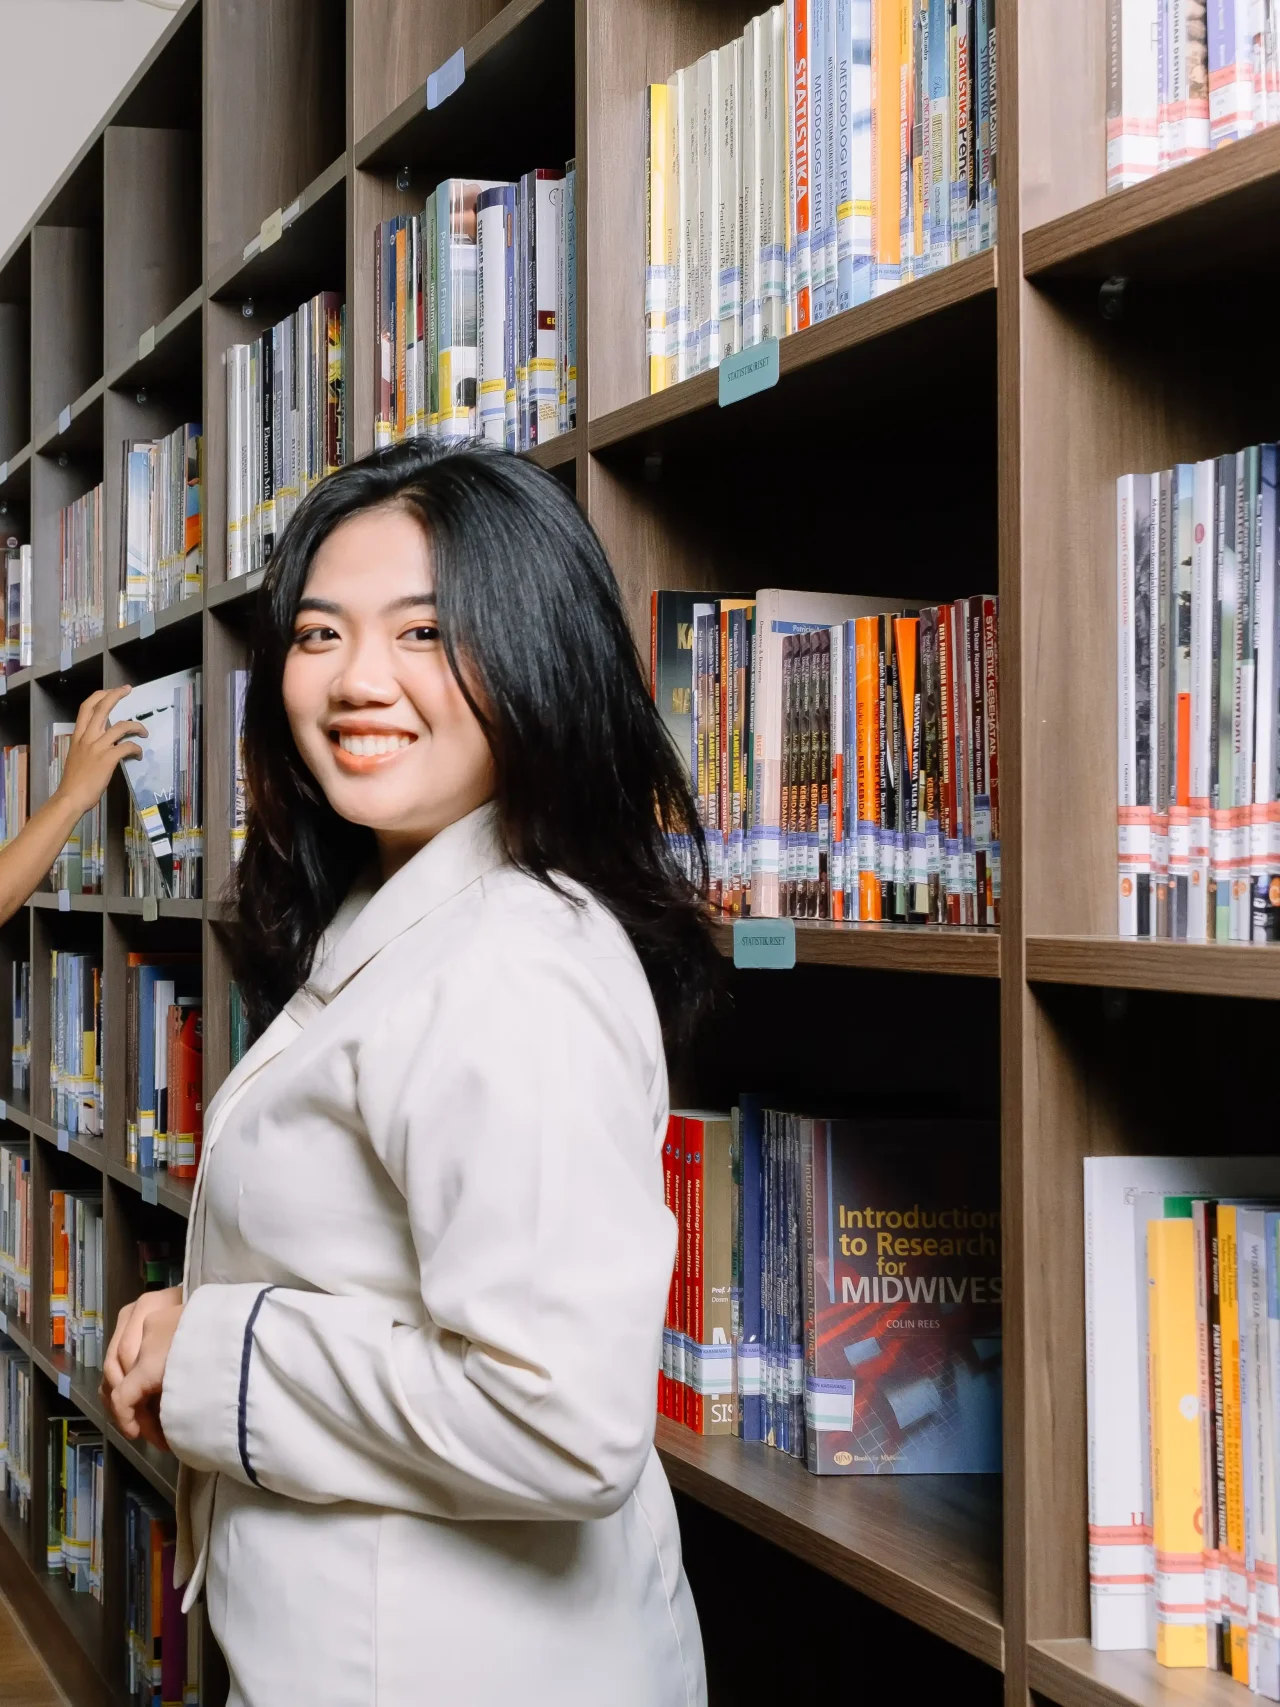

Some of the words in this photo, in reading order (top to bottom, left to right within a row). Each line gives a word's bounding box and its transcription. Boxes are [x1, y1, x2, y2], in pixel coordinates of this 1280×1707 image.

[900, 65, 908, 120] Structural
[980, 46, 989, 120] STATISTIKA
[795, 57, 807, 204] STATISTIKA
[814, 74, 822, 179] METODOLOGI
[839, 60, 847, 166] METODOLOGI
[900, 172, 908, 218] Modelin
[986, 615, 994, 677] STATISTIK
[913, 693, 921, 749] MENYIAPKAN
[988, 680, 996, 756] KESEHATAN
[912, 751, 920, 780] KARYA
[810, 783, 818, 832] KEBIDANAN
[805, 1163, 813, 1233] Introduction
[838, 1204, 1001, 1229] Introduction
[838, 1232, 868, 1257] to
[876, 1231, 996, 1257] Research
[876, 1256, 907, 1276] for
[842, 1276, 1002, 1304] MIDWIVES
[886, 1318, 916, 1329] COLIN
[917, 1318, 941, 1329] REES
